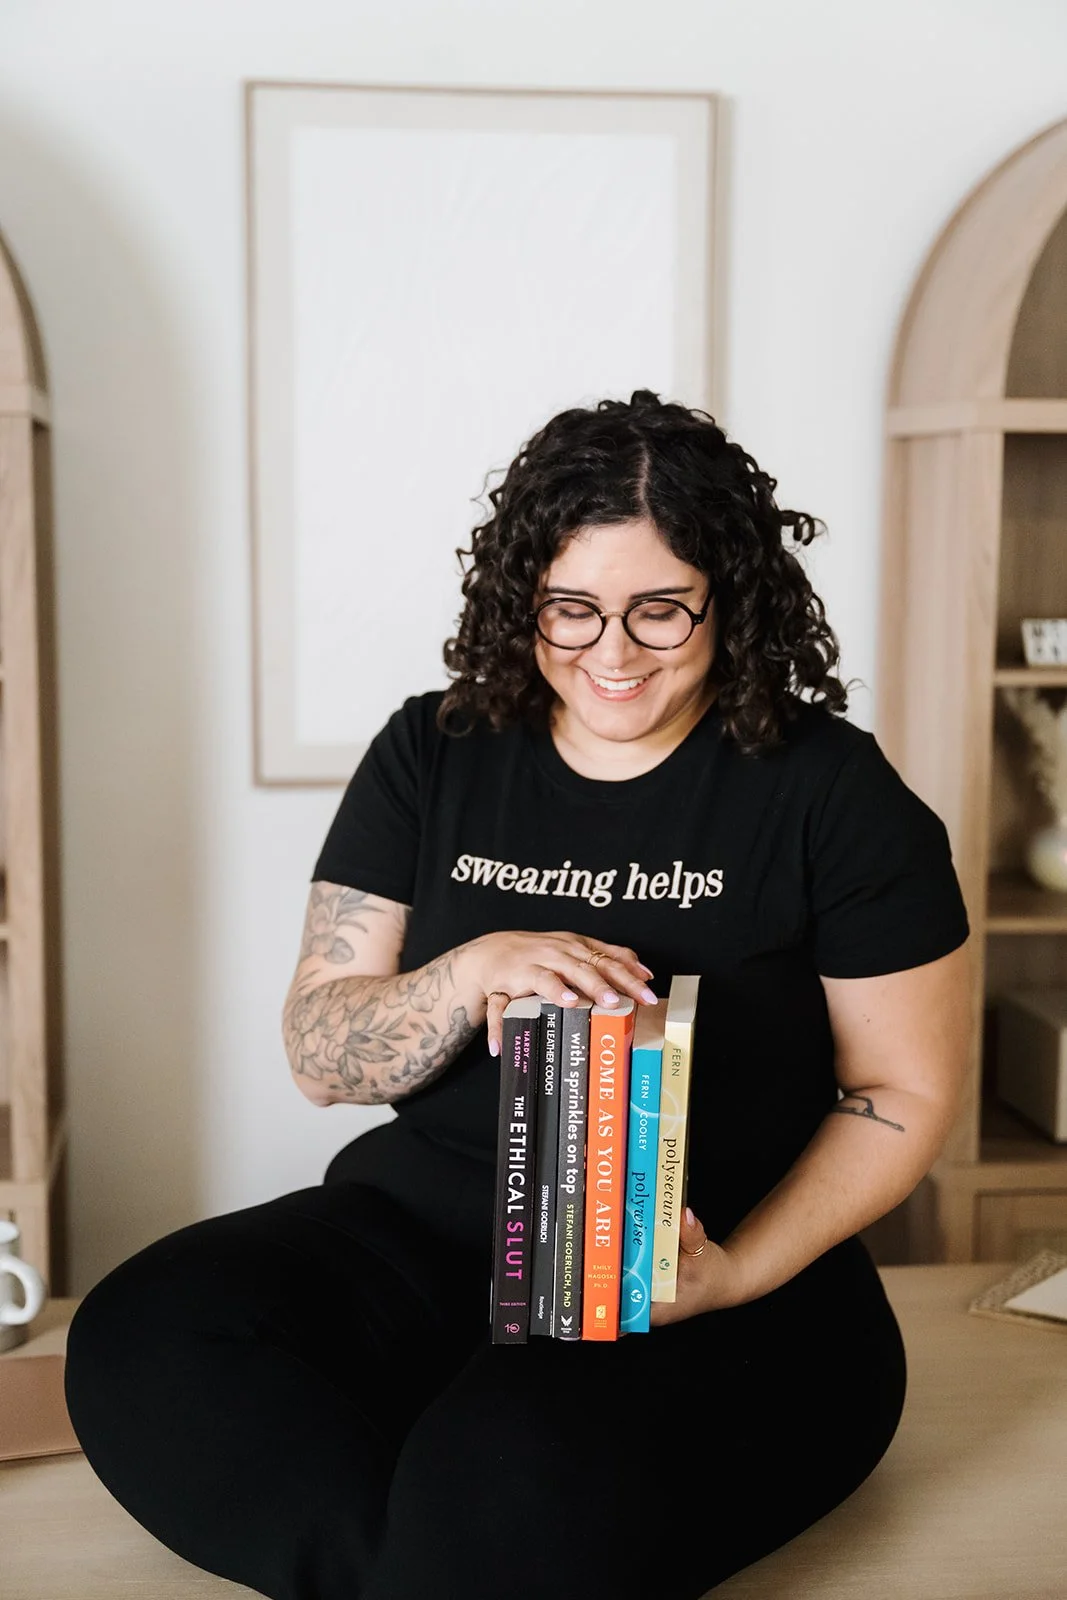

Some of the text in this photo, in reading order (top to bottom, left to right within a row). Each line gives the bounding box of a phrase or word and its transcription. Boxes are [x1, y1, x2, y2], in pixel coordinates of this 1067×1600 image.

[451, 854, 723, 908] swearing helps
[523, 1030, 531, 1058] HARDY
[544, 1012, 556, 1095] THE LEATHER COUCH
[671, 1048, 681, 1077] FERN
[560, 1032, 585, 1194] with sprinkles on top
[595, 1034, 616, 1247] COME AS YOU ARE
[638, 1074, 650, 1150] FERN COOLEY
[505, 1096, 527, 1280] THE ETHICAL SLUT
[540, 1184, 549, 1243] STEFANI GOERLICH
[631, 1171, 650, 1246] polywise
[662, 1138, 680, 1227] polysecure
[563, 1204, 574, 1308] STEFANI GOERLICH, PhD
